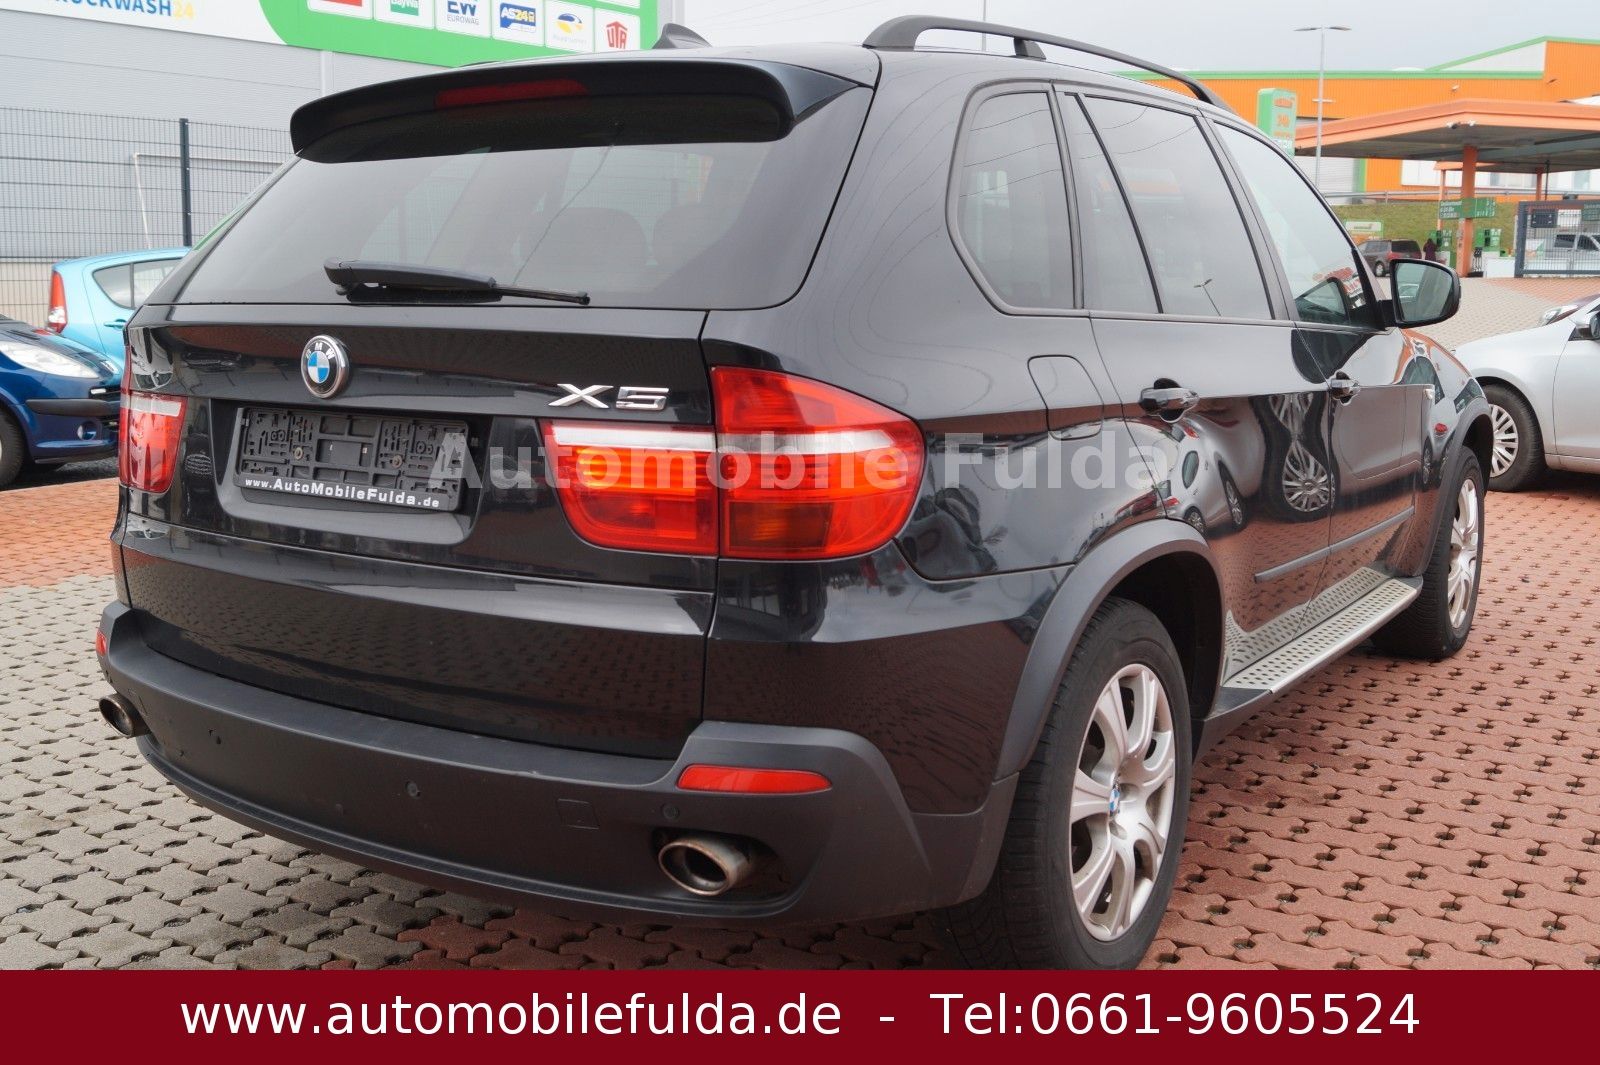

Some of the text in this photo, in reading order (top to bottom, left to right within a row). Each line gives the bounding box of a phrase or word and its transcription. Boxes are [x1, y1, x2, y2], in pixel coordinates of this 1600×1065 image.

[447, 14, 479, 25] EUROWAG
[605, 20, 628, 49] UTA
[305, 342, 335, 360] BMW
[548, 383, 669, 412] X5
[245, 478, 440, 507] www.AutoMobileFulda.de
